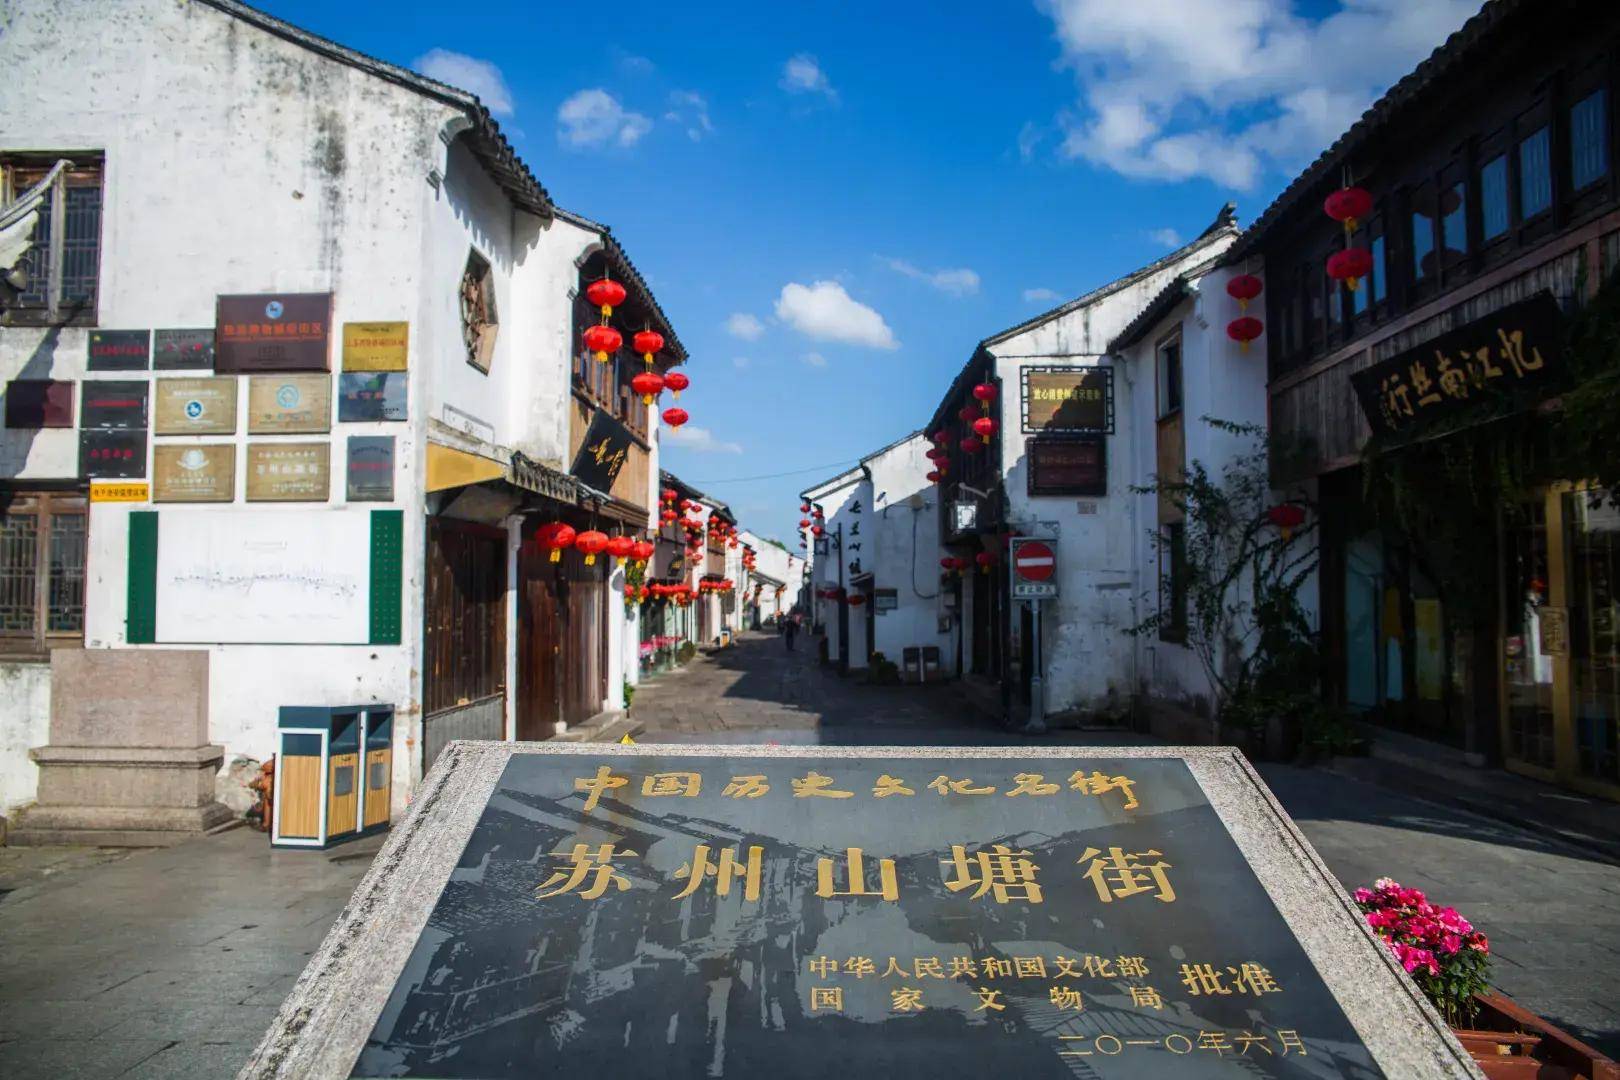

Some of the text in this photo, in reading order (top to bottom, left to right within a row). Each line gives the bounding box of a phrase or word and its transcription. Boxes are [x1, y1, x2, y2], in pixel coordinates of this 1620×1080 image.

[574, 766, 1138, 811] 中国历史文化名街
[535, 845, 1176, 903] 苏州山塘街
[809, 955, 1150, 979] 中华人民共和国文化部
[1179, 963, 1283, 996] 批准
[810, 985, 1164, 1012] 国家文物局
